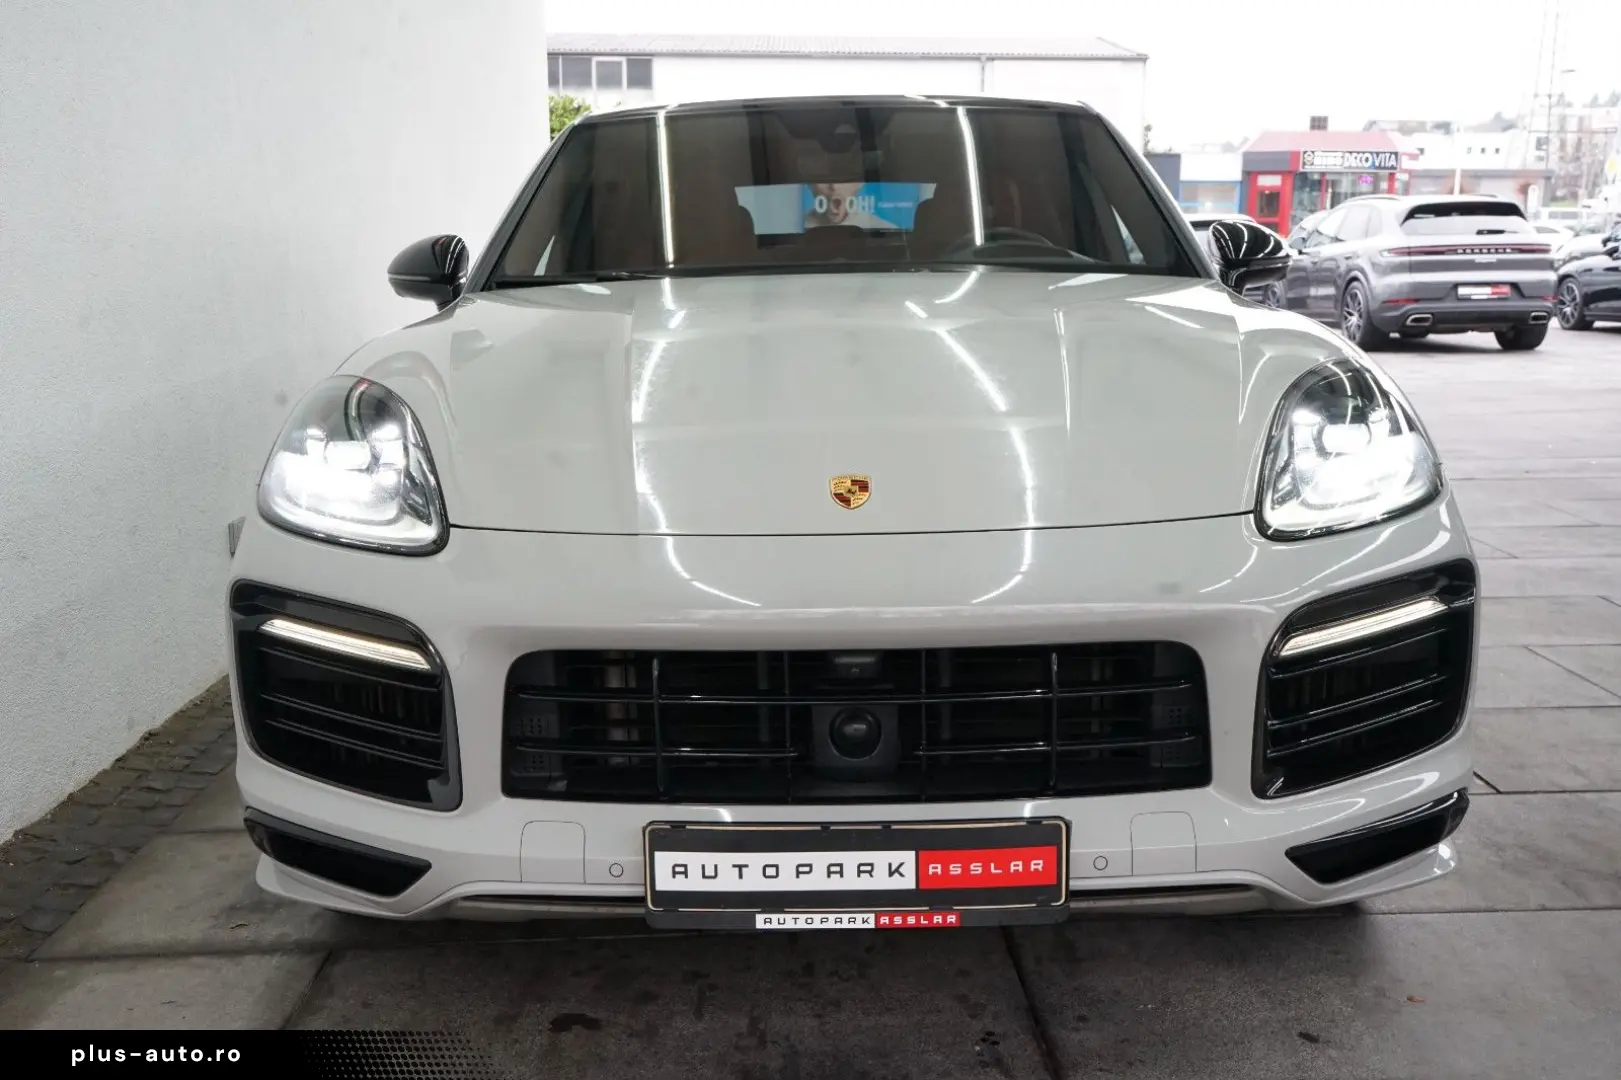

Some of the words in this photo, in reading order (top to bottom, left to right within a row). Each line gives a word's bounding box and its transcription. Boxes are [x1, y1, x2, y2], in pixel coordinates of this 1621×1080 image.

[671, 862, 906, 880] AUTOPARK
[928, 860, 1044, 876] ASSLAR
[763, 916, 870, 925] AUTOPARK
[879, 915, 956, 925] ASSLAR
